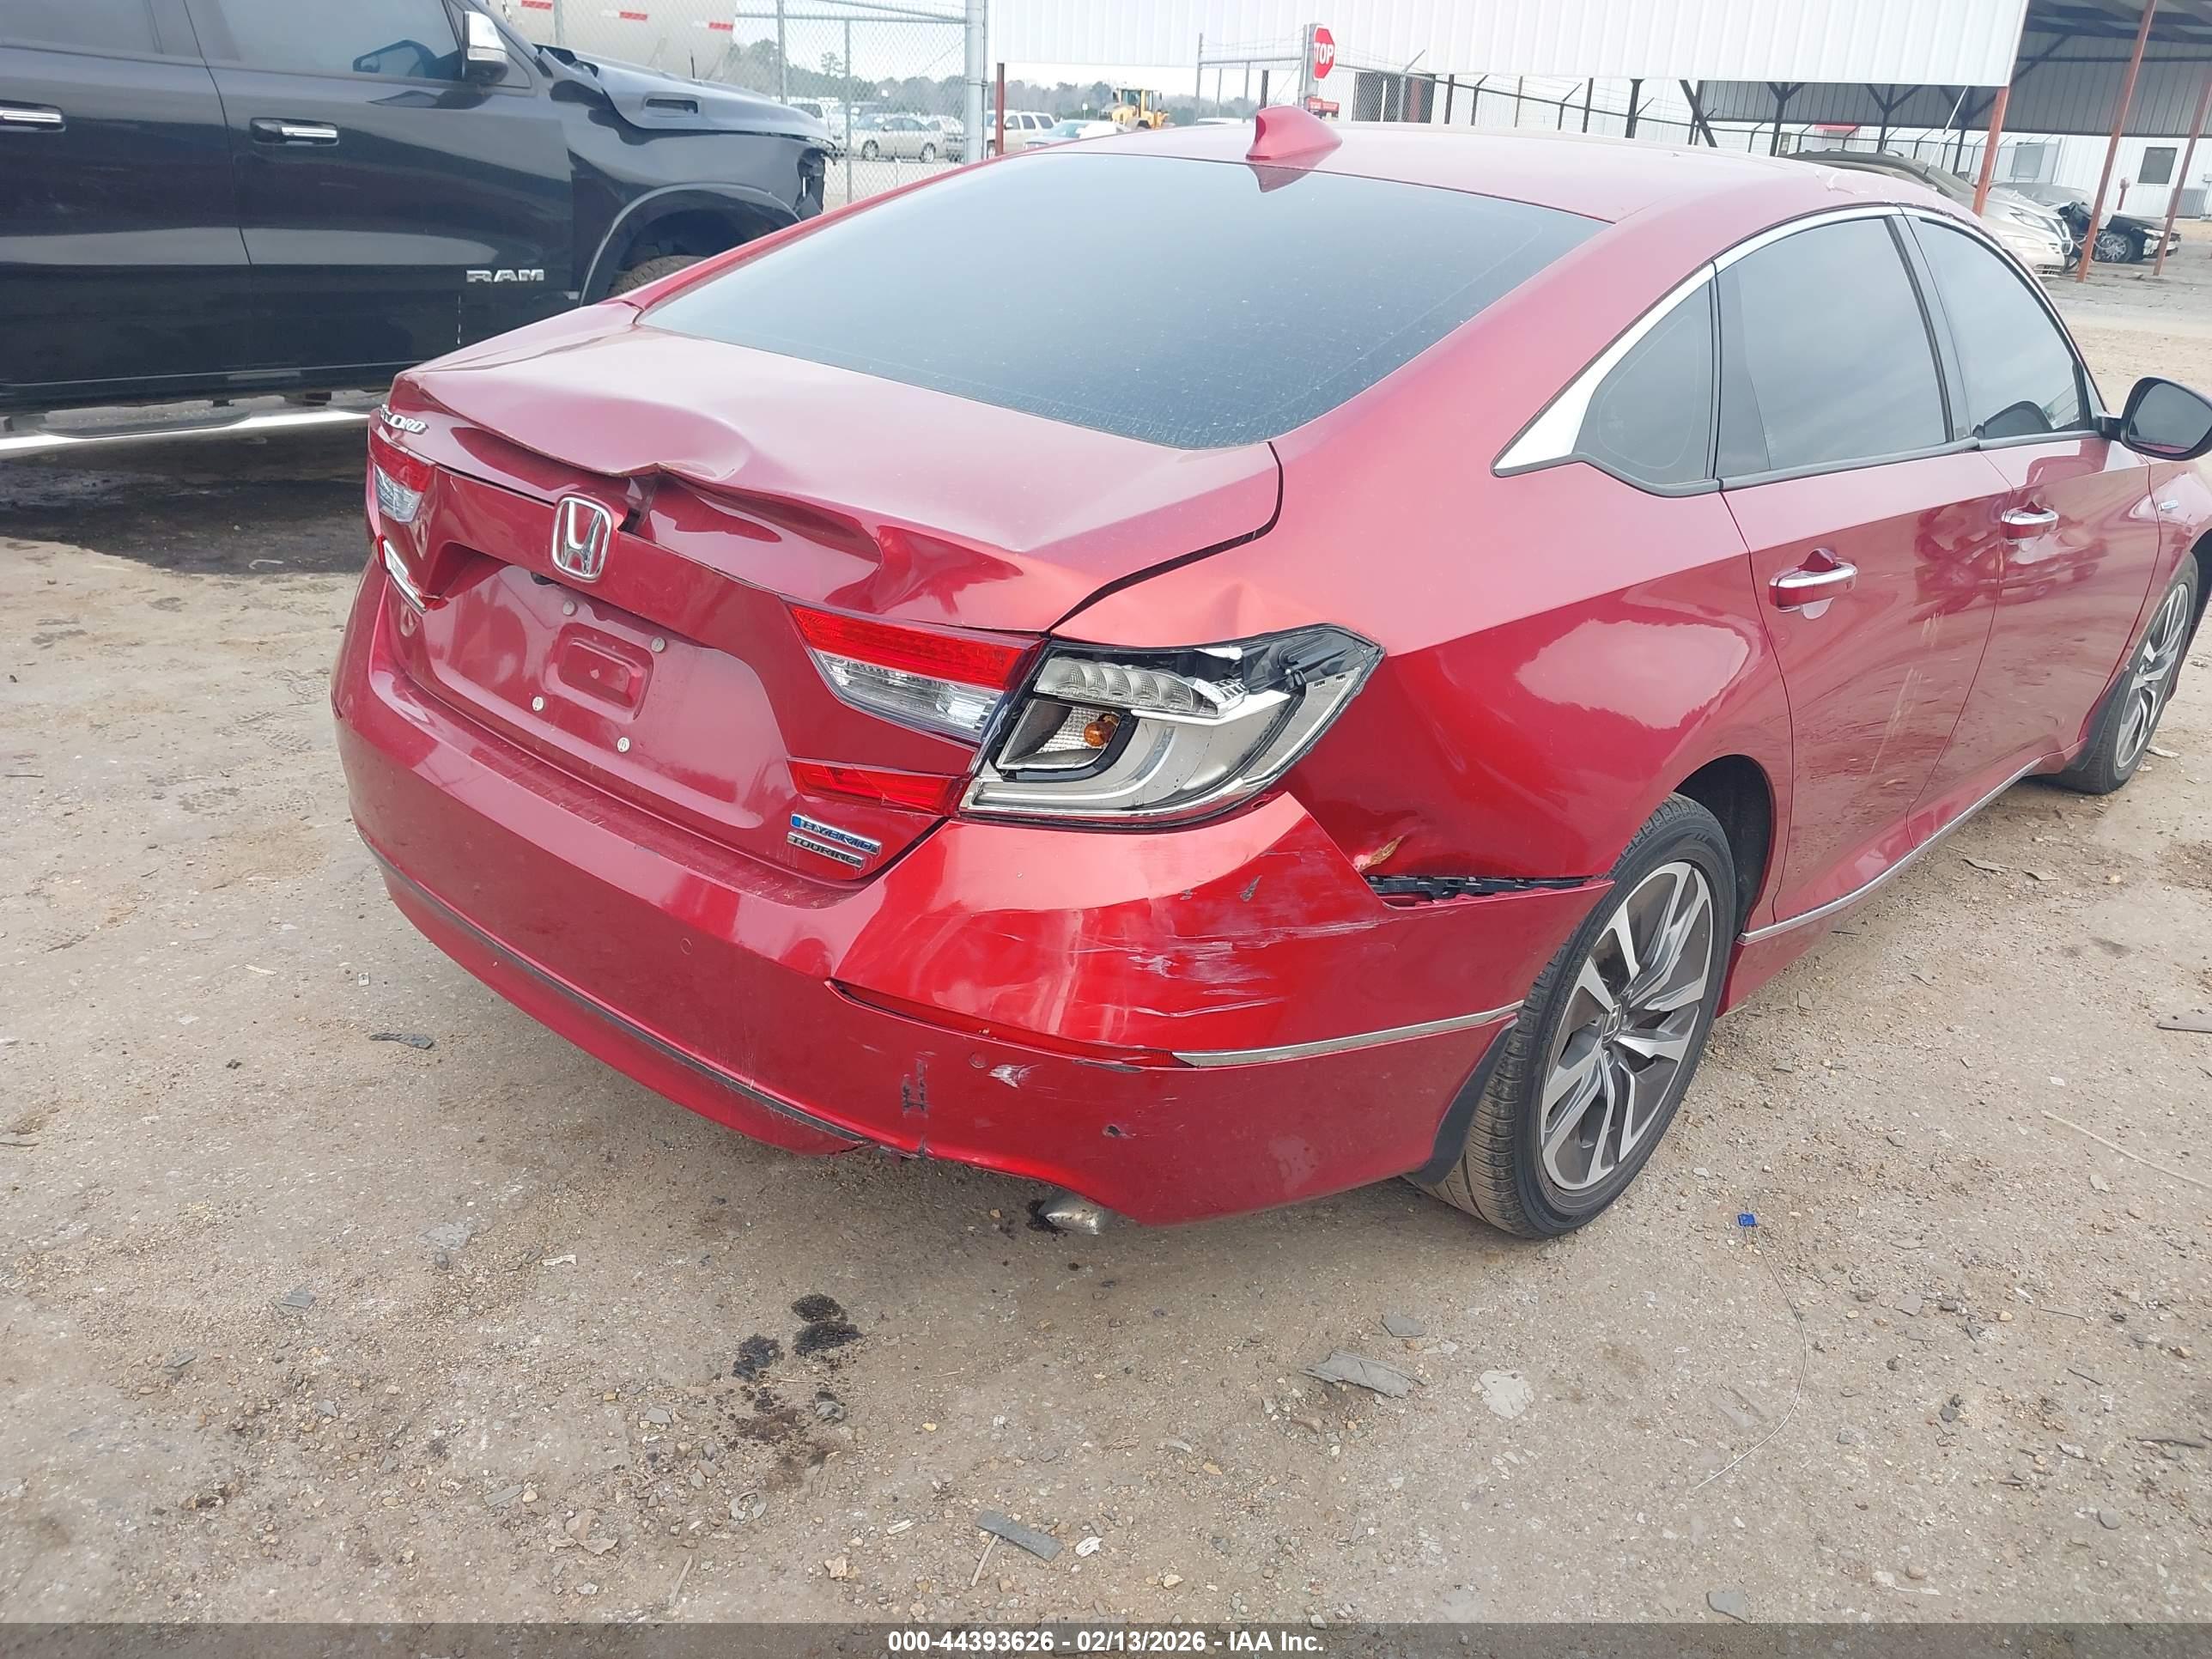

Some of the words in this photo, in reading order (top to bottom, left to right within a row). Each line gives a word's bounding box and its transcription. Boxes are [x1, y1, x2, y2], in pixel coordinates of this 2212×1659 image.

[1314, 42, 1334, 65] TOP
[466, 269, 544, 283] RAM
[803, 819, 873, 850] HYBRID
